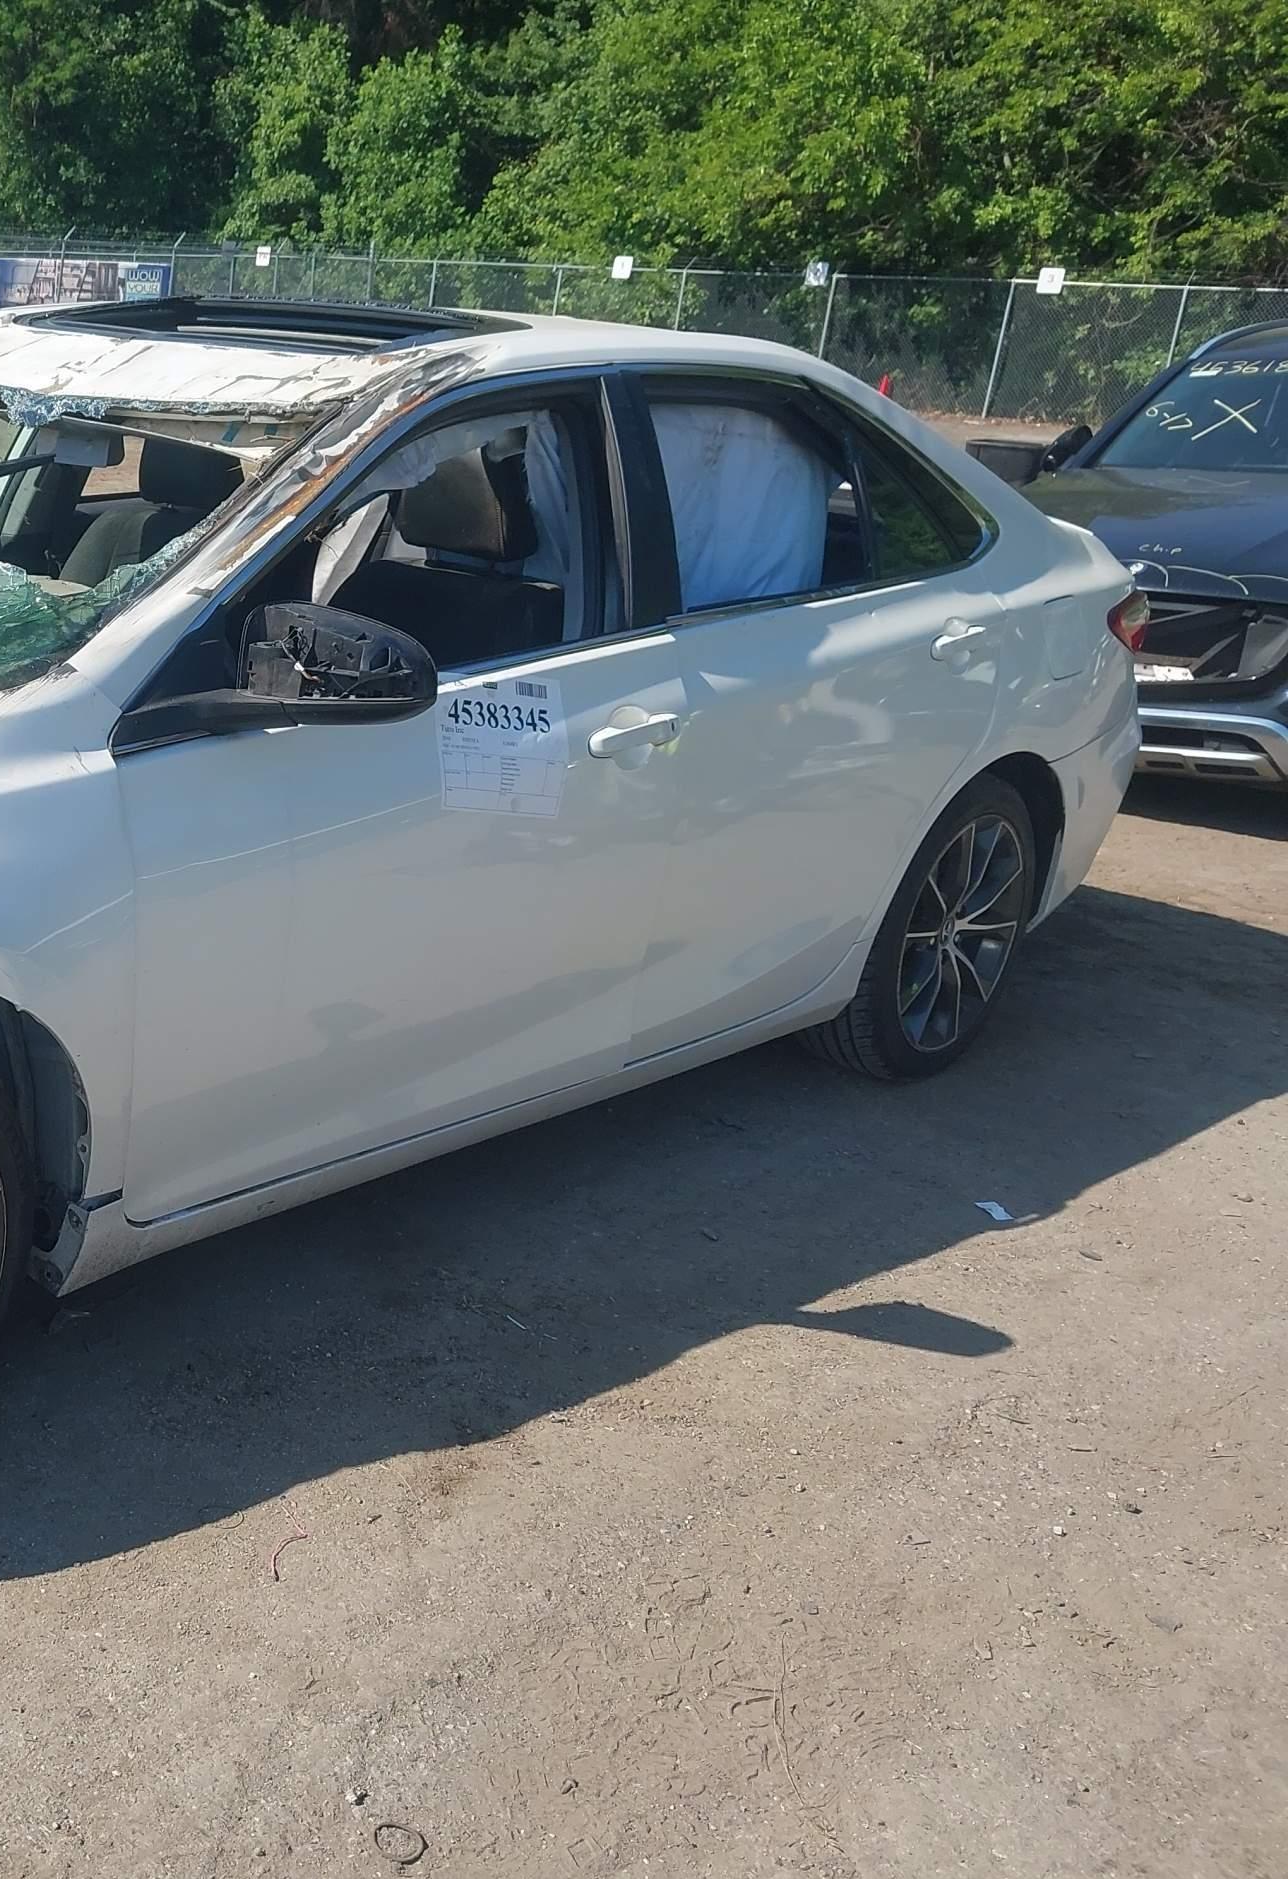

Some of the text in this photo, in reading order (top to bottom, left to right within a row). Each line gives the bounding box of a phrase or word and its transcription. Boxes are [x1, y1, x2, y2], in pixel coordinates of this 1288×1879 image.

[128, 270, 160, 282] WOW
[128, 283, 159, 293] YOUR
[447, 698, 551, 733] 45383345
